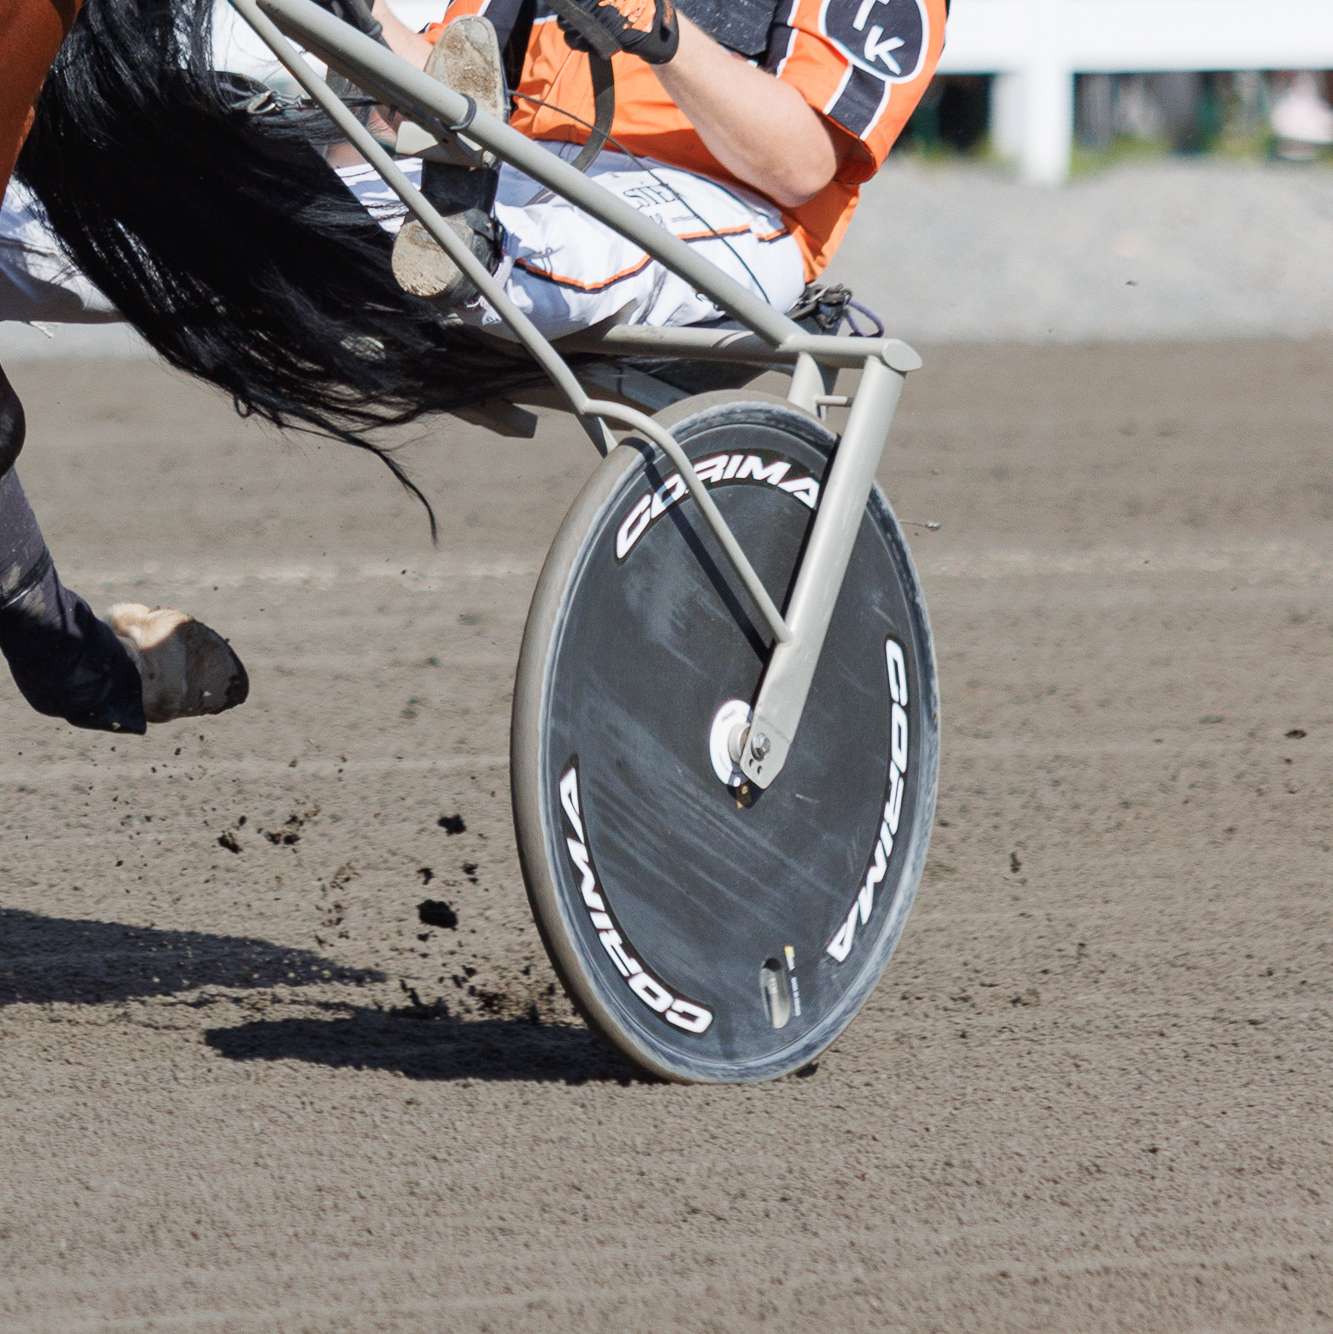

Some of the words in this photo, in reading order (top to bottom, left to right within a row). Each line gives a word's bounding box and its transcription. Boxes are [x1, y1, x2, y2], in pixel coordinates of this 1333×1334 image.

[616, 454, 820, 559] CORIMA
[559, 767, 713, 1034] CORIMA
[826, 639, 908, 962] CORIMA
